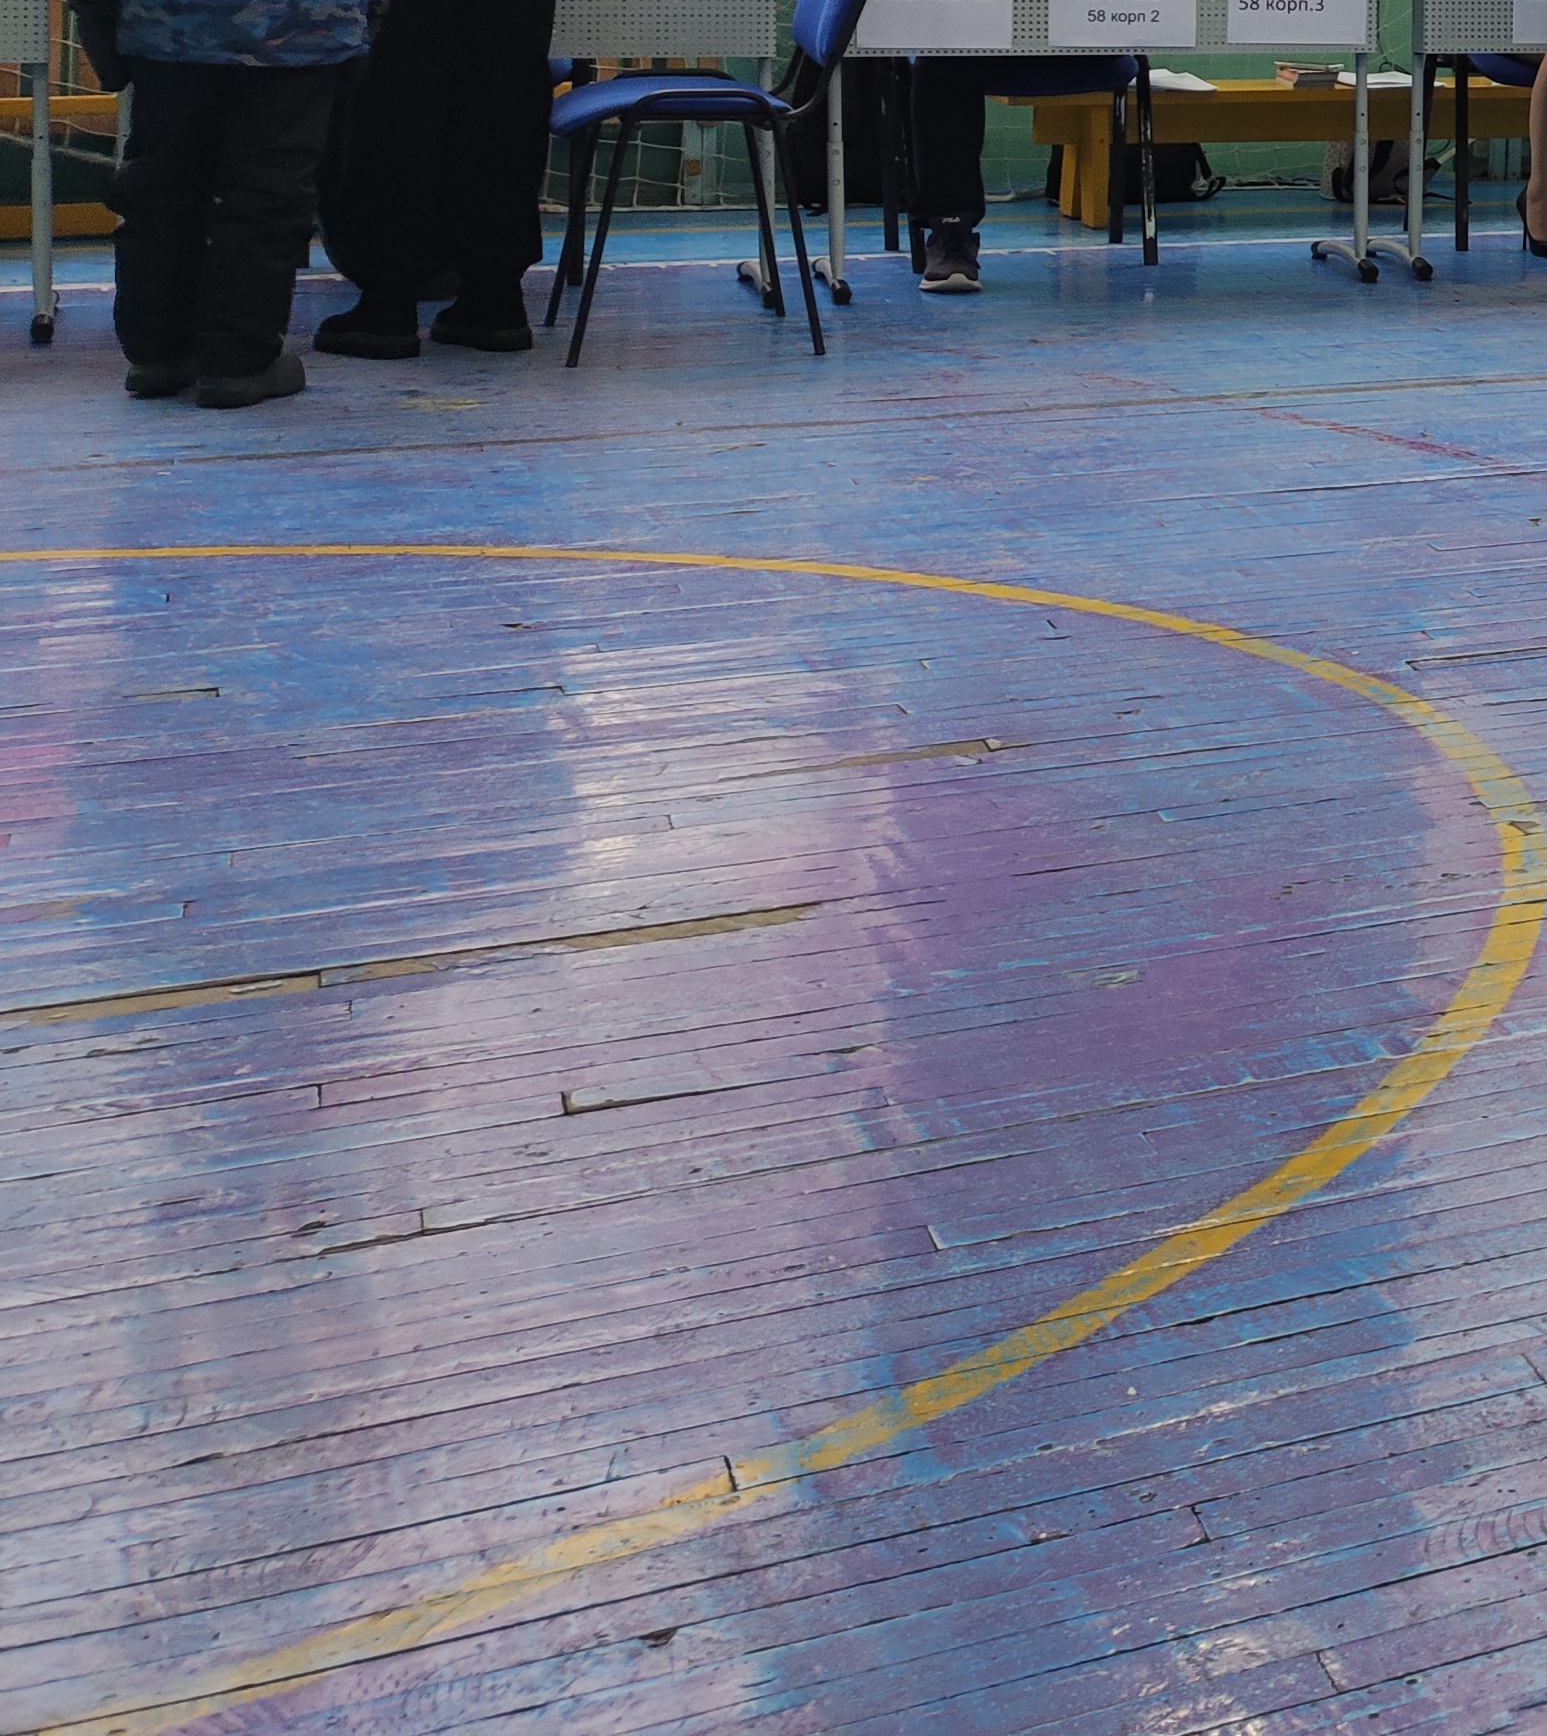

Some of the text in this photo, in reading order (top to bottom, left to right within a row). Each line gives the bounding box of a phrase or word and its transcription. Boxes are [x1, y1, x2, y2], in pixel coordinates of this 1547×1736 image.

[1087, 9, 1160, 26] 58 корп 2
